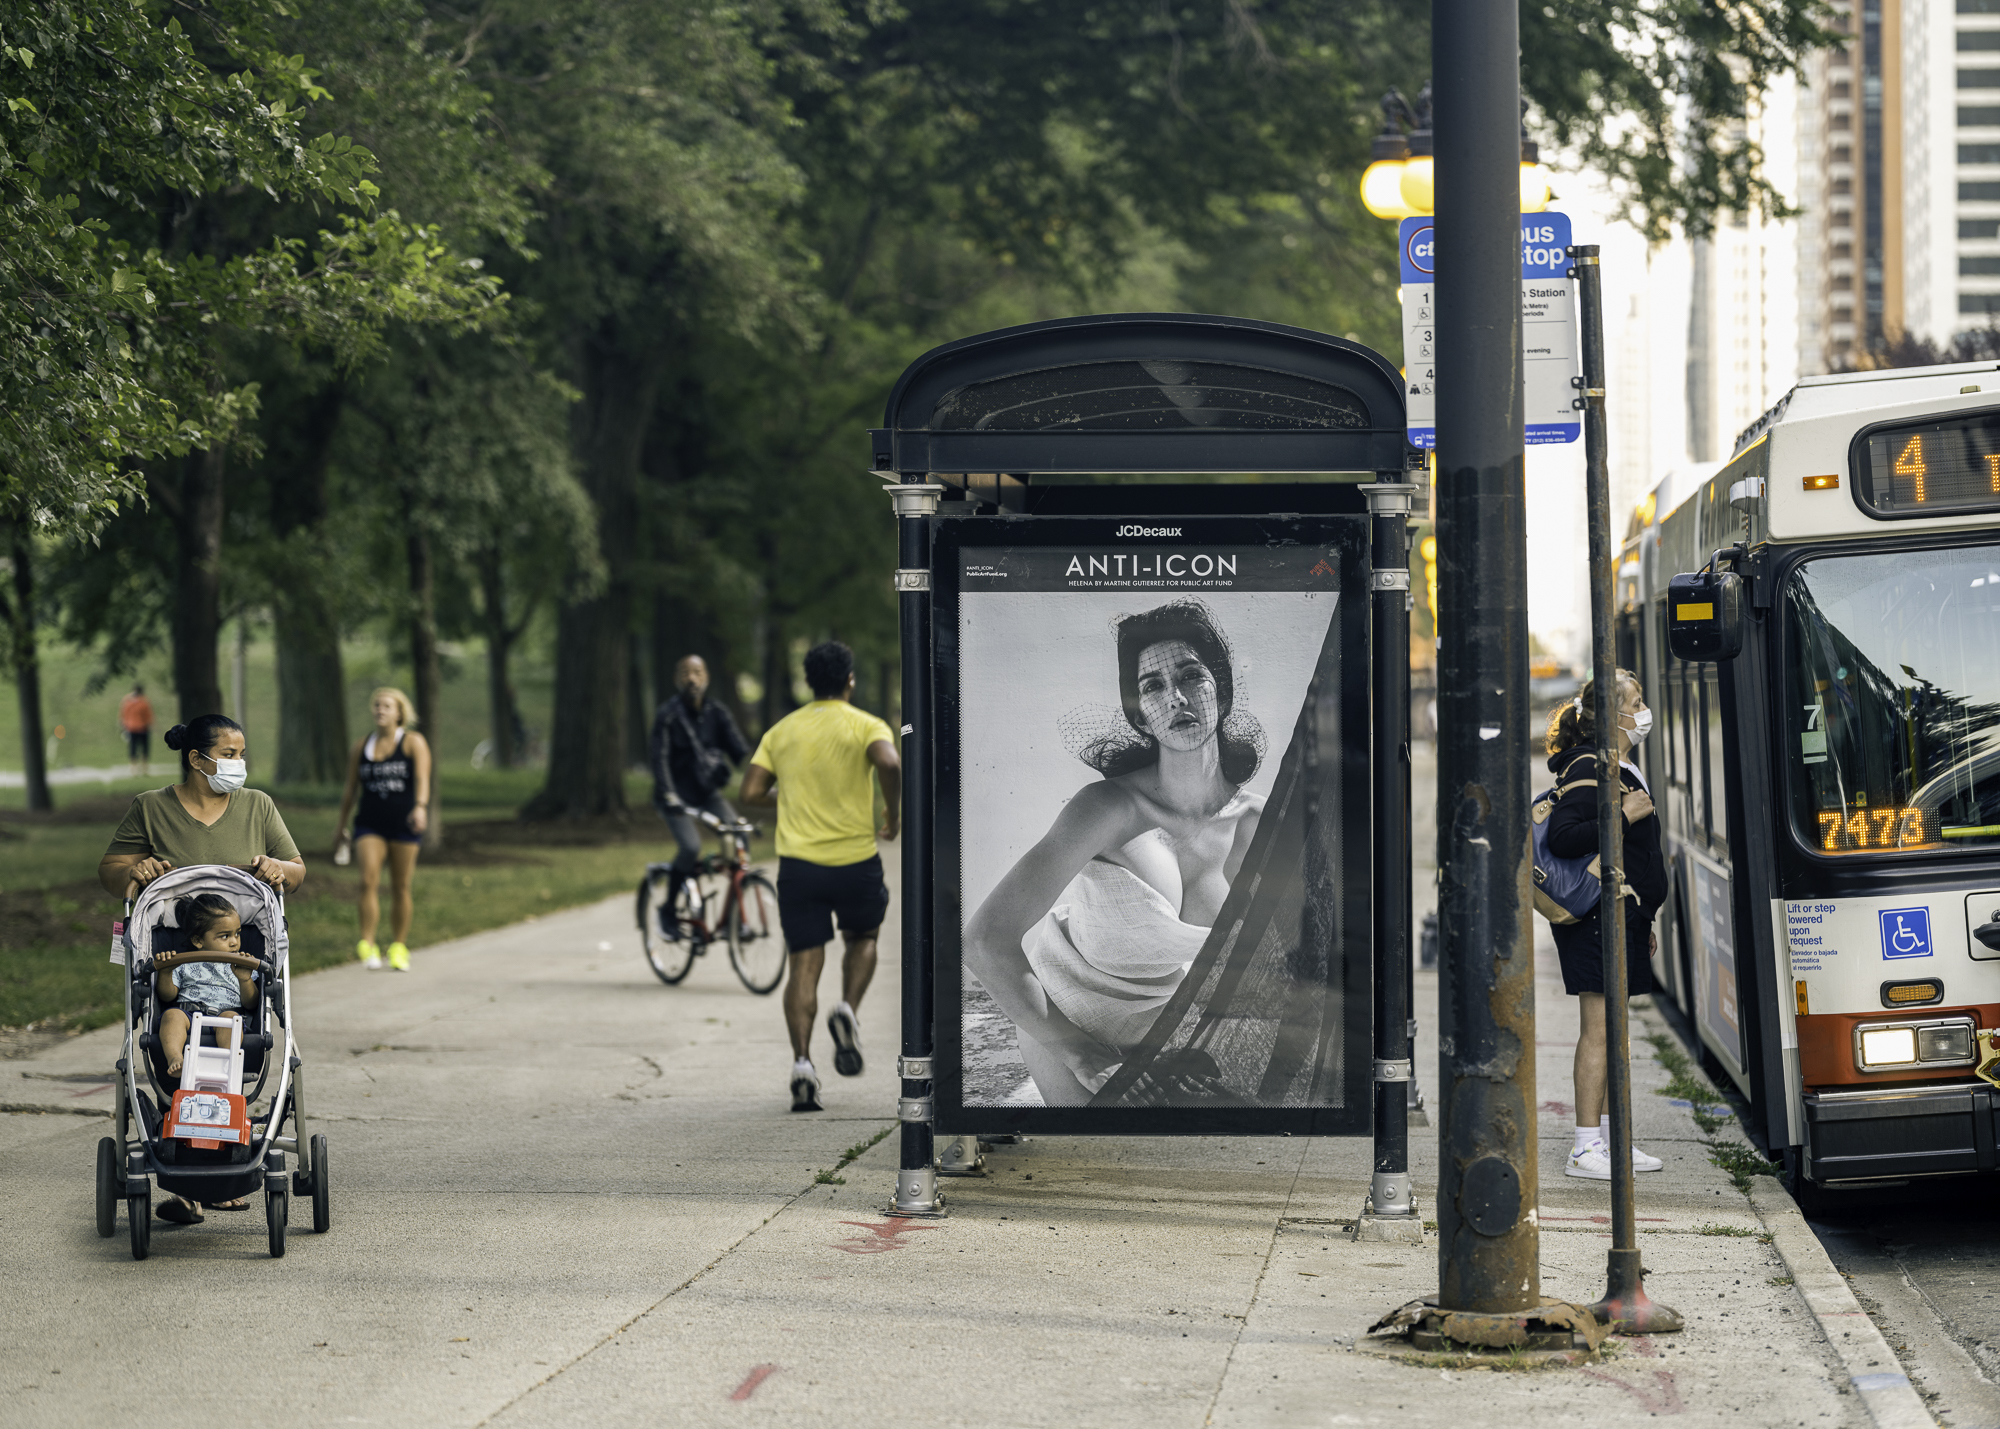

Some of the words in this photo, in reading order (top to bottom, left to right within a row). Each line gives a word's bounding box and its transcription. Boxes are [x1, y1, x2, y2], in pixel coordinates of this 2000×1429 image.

[1415, 241, 1434, 257] ct
[1521, 246, 1565, 270] top
[1423, 292, 1428, 304] 1
[1529, 289, 1566, 298] Station
[1424, 331, 1432, 342] 3
[1426, 369, 1434, 380] 4
[1896, 435, 1925, 502] 4
[1116, 525, 1182, 536] JCDecaux
[1065, 554, 1236, 576] ANTI-ICON
[1804, 704, 1821, 730] 7
[1819, 808, 1924, 848] 7473
[1788, 904, 1801, 913] Lift
[1814, 904, 1836, 914] step
[1788, 914, 1822, 924] lowered
[1789, 928, 1810, 937] upon
[1790, 936, 1822, 947] request
